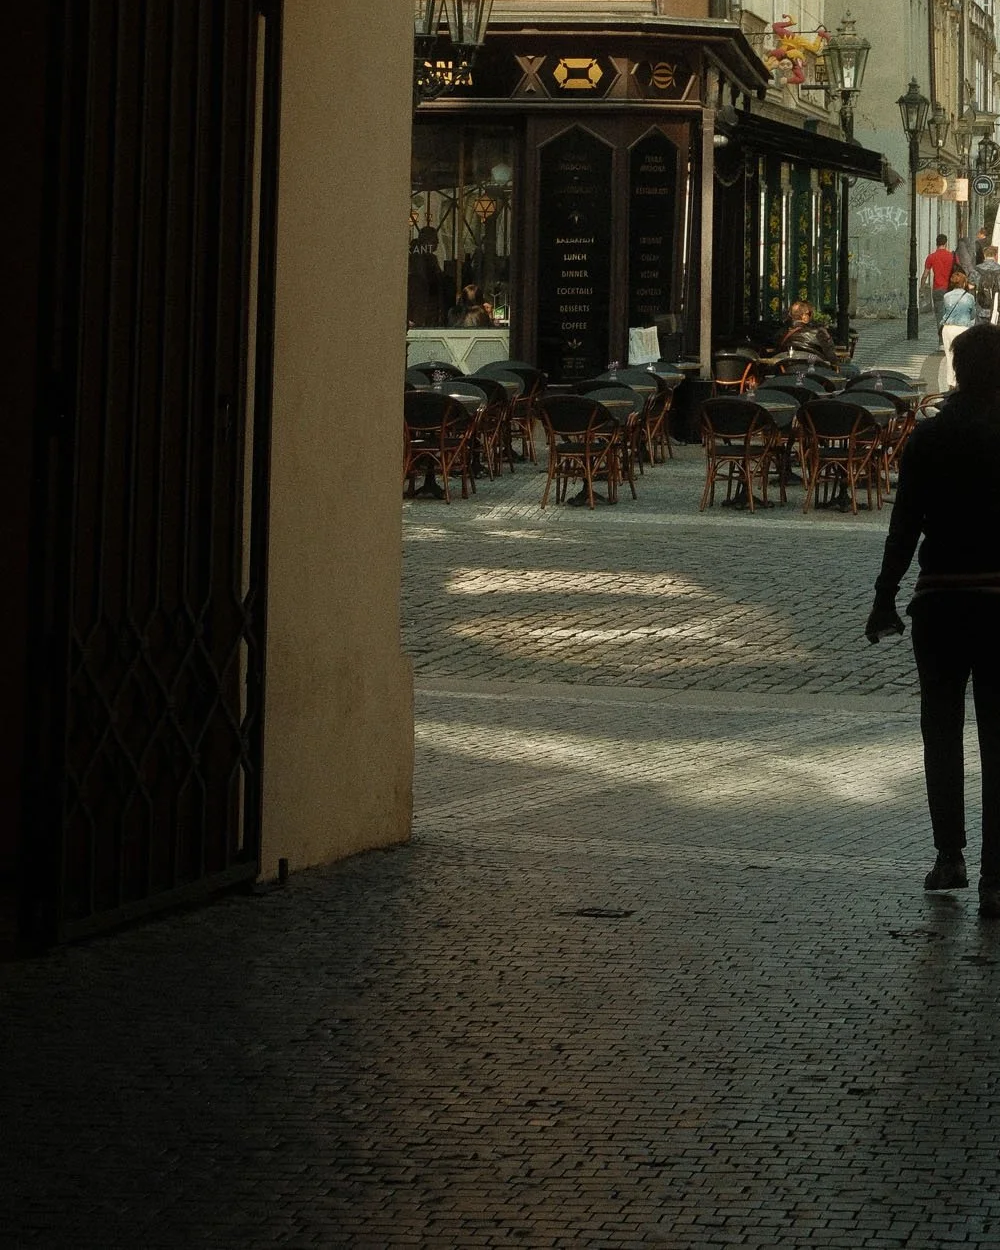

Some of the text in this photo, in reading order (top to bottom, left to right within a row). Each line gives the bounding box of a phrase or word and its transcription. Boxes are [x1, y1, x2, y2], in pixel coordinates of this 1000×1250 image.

[563, 253, 587, 261] LUNCH
[561, 270, 588, 278] DINNER
[556, 287, 593, 295] COCKTAILS
[559, 304, 590, 313] DESSERTS
[561, 321, 587, 330] COFFEE
